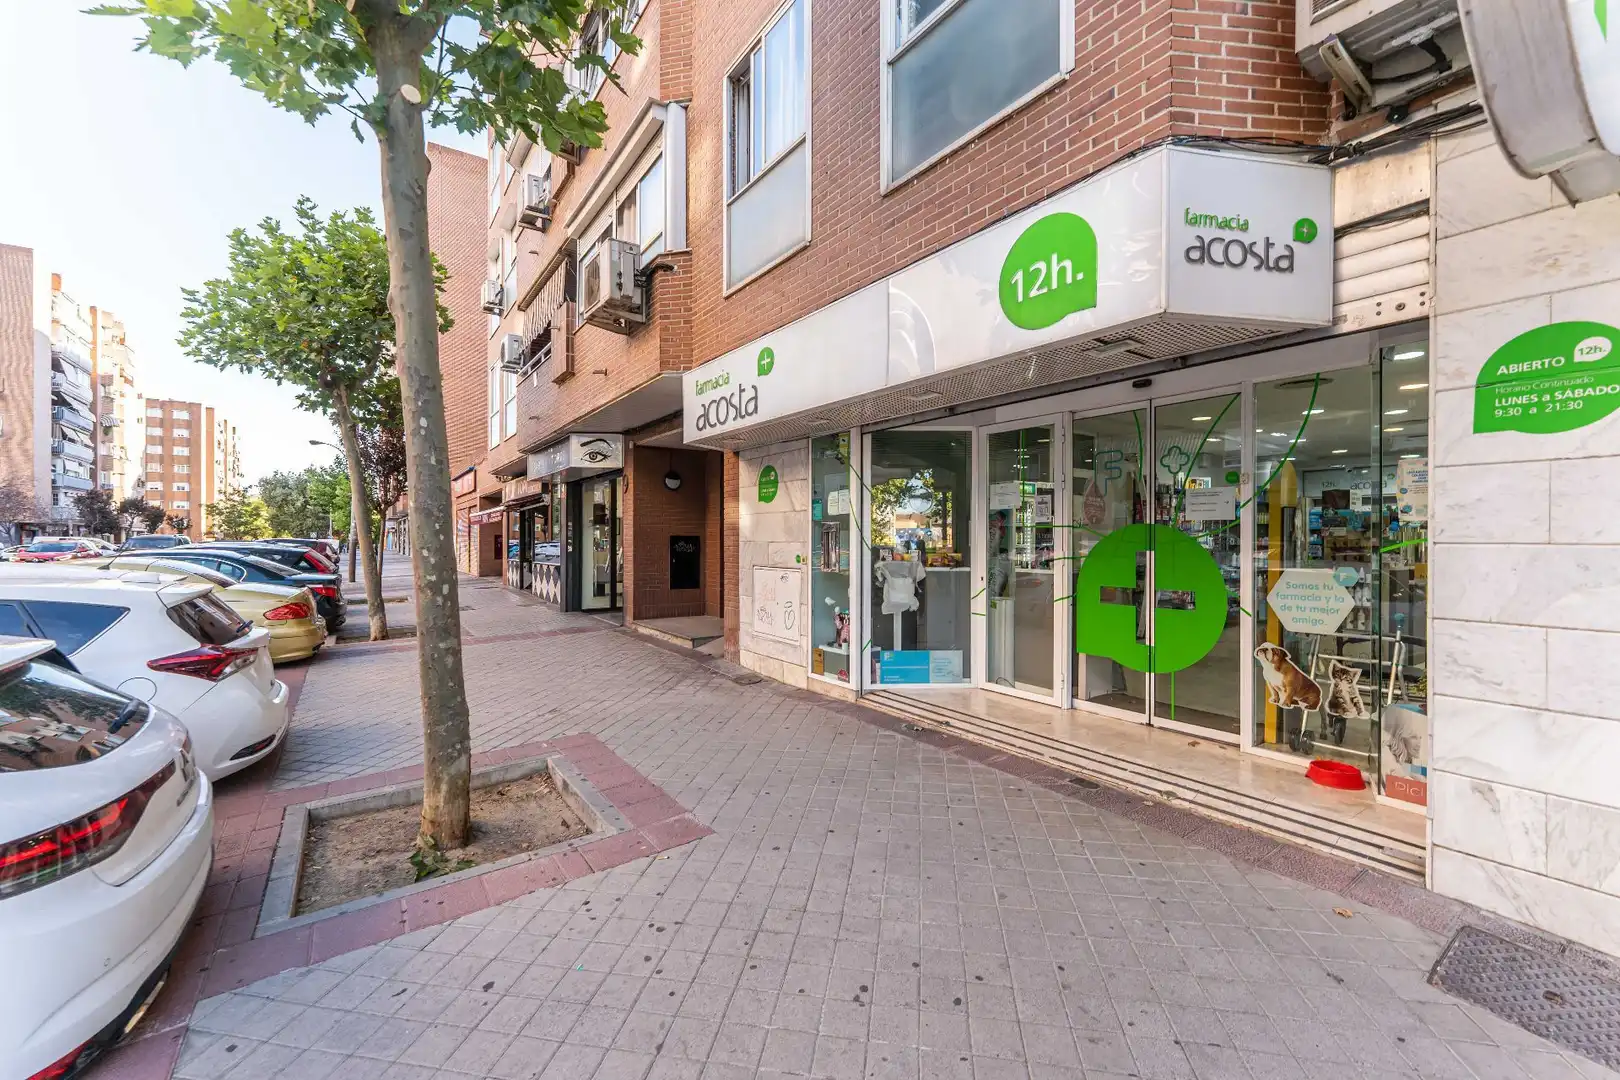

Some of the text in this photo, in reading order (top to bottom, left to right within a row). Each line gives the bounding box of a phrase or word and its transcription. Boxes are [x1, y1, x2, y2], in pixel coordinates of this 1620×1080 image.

[1183, 207, 1249, 233] farmacia
[1184, 235, 1295, 273] acosta
[1009, 252, 1084, 303] 12h.
[1578, 345, 1607, 356] 12h.
[1496, 356, 1565, 376] ABIERTO
[695, 369, 730, 396] farmacia
[1495, 376, 1594, 394] Horario Continuado
[695, 383, 758, 432] acosta
[1494, 406, 1522, 418] 9:30
[1545, 400, 1583, 412] 21:30
[1495, 393, 1539, 407] LUNES
[1542, 394, 1550, 402] a
[1285, 581, 1334, 591] Somos tu
[1276, 592, 1345, 604] farmacia y la
[1280, 603, 1340, 615] de tu mejor
[1291, 616, 1327, 627] amigo.
